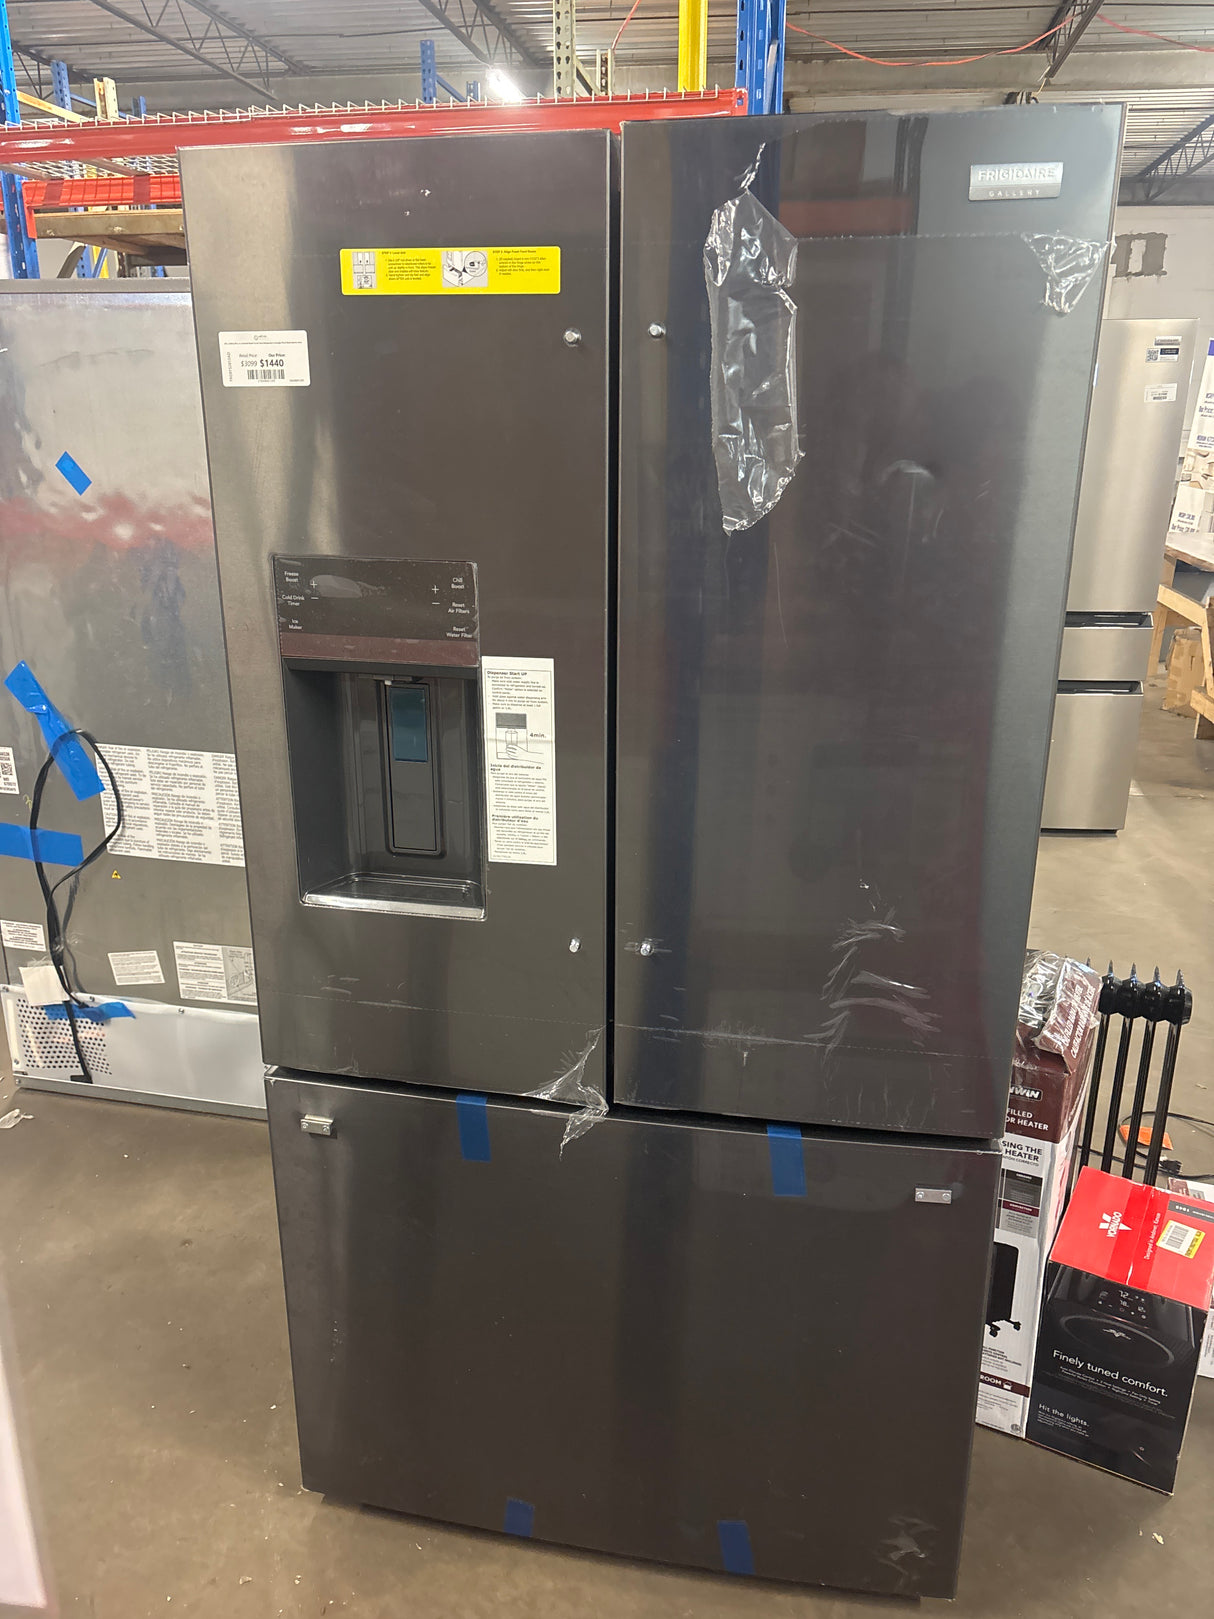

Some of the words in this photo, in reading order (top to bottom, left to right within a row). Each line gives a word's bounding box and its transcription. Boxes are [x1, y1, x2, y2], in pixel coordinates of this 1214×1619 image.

[978, 168, 1056, 180] FRIGIDAIRE
[260, 359, 284, 367] $1440
[1007, 1108, 1033, 1118] FILLED
[1017, 1118, 1048, 1130] HEATER
[1002, 1141, 1023, 1150] SING
[1025, 1145, 1042, 1155] THE
[1006, 1149, 1039, 1161] HEATER
[1106, 1212, 1122, 1238] VORNADO
[1053, 1350, 1084, 1369] Finely
[1087, 1363, 1119, 1379] tuned
[1122, 1376, 1168, 1397] comfort.
[980, 1375, 1001, 1385] ROOM
[1039, 1404, 1050, 1413] Hit
[1052, 1406, 1064, 1417] the
[1067, 1414, 1089, 1427] lights.
